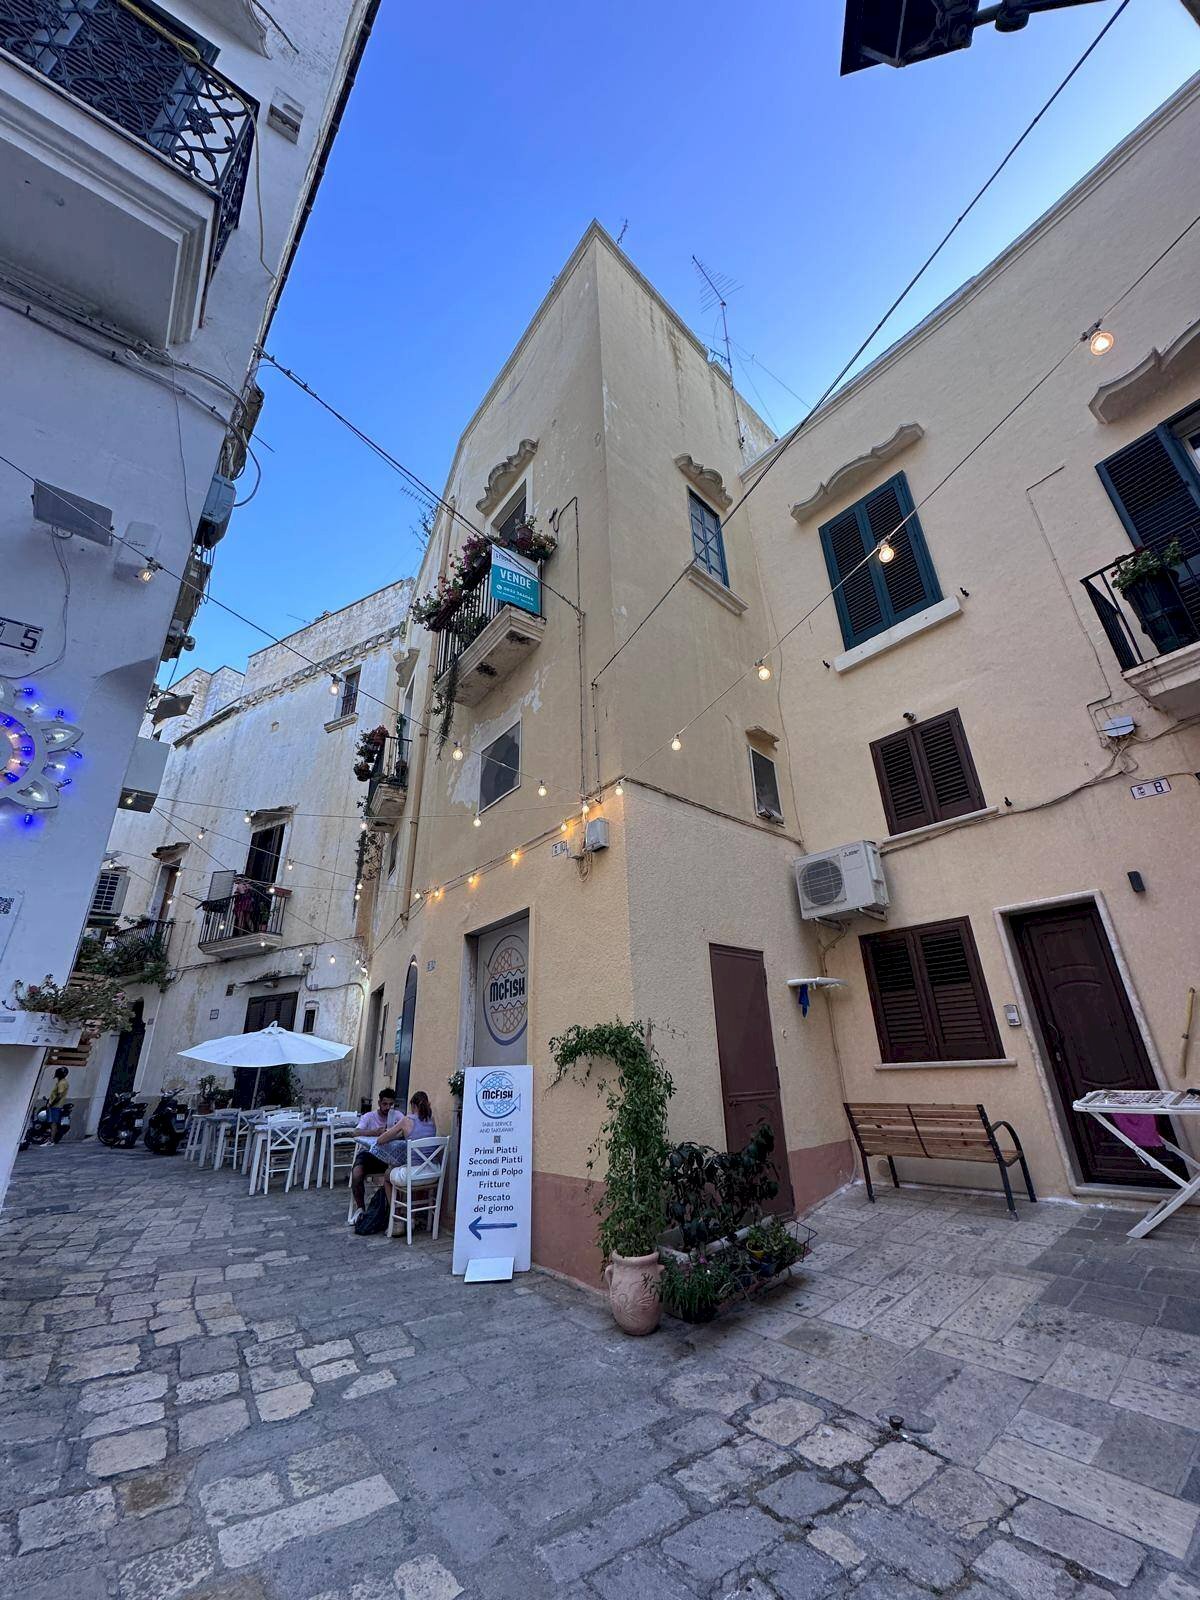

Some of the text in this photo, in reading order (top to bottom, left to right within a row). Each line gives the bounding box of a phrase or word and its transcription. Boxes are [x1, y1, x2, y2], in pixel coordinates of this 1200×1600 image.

[500, 569, 531, 589] VENDE
[21, 629, 39, 650] 5
[1154, 781, 1164, 793] 8
[474, 1146, 518, 1155] Primi Piatti
[468, 1156, 523, 1165] Secondi Piatti
[467, 1168, 523, 1177] Panini di Polpo
[478, 1194, 511, 1202] Pescato
[473, 1204, 514, 1214] del giorno
